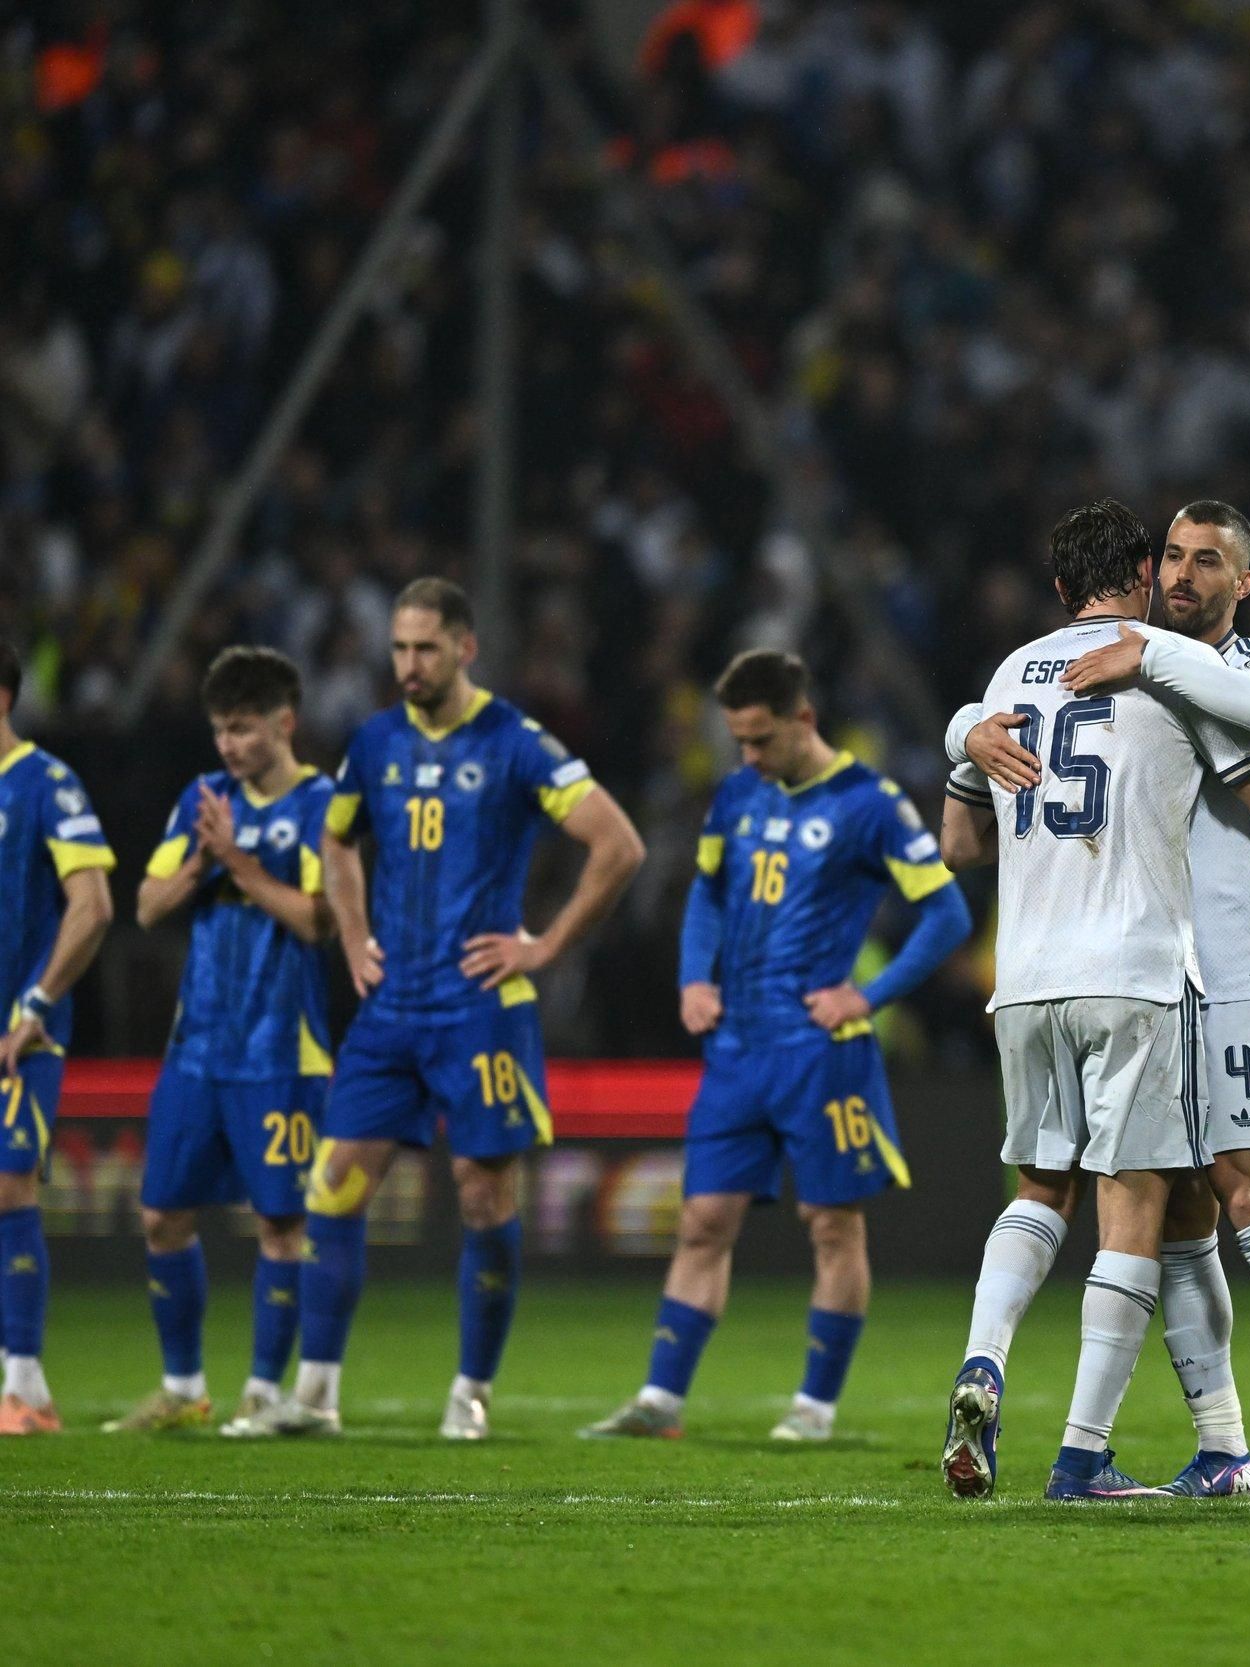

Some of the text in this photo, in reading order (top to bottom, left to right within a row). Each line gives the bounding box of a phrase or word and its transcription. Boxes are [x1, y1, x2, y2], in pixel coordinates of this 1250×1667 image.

[1012, 696, 1116, 839] 15
[405, 796, 445, 851] 18
[751, 848, 789, 905] 16
[471, 1050, 518, 1108] 18
[262, 1110, 312, 1166] 20
[823, 1094, 871, 1154] 16
